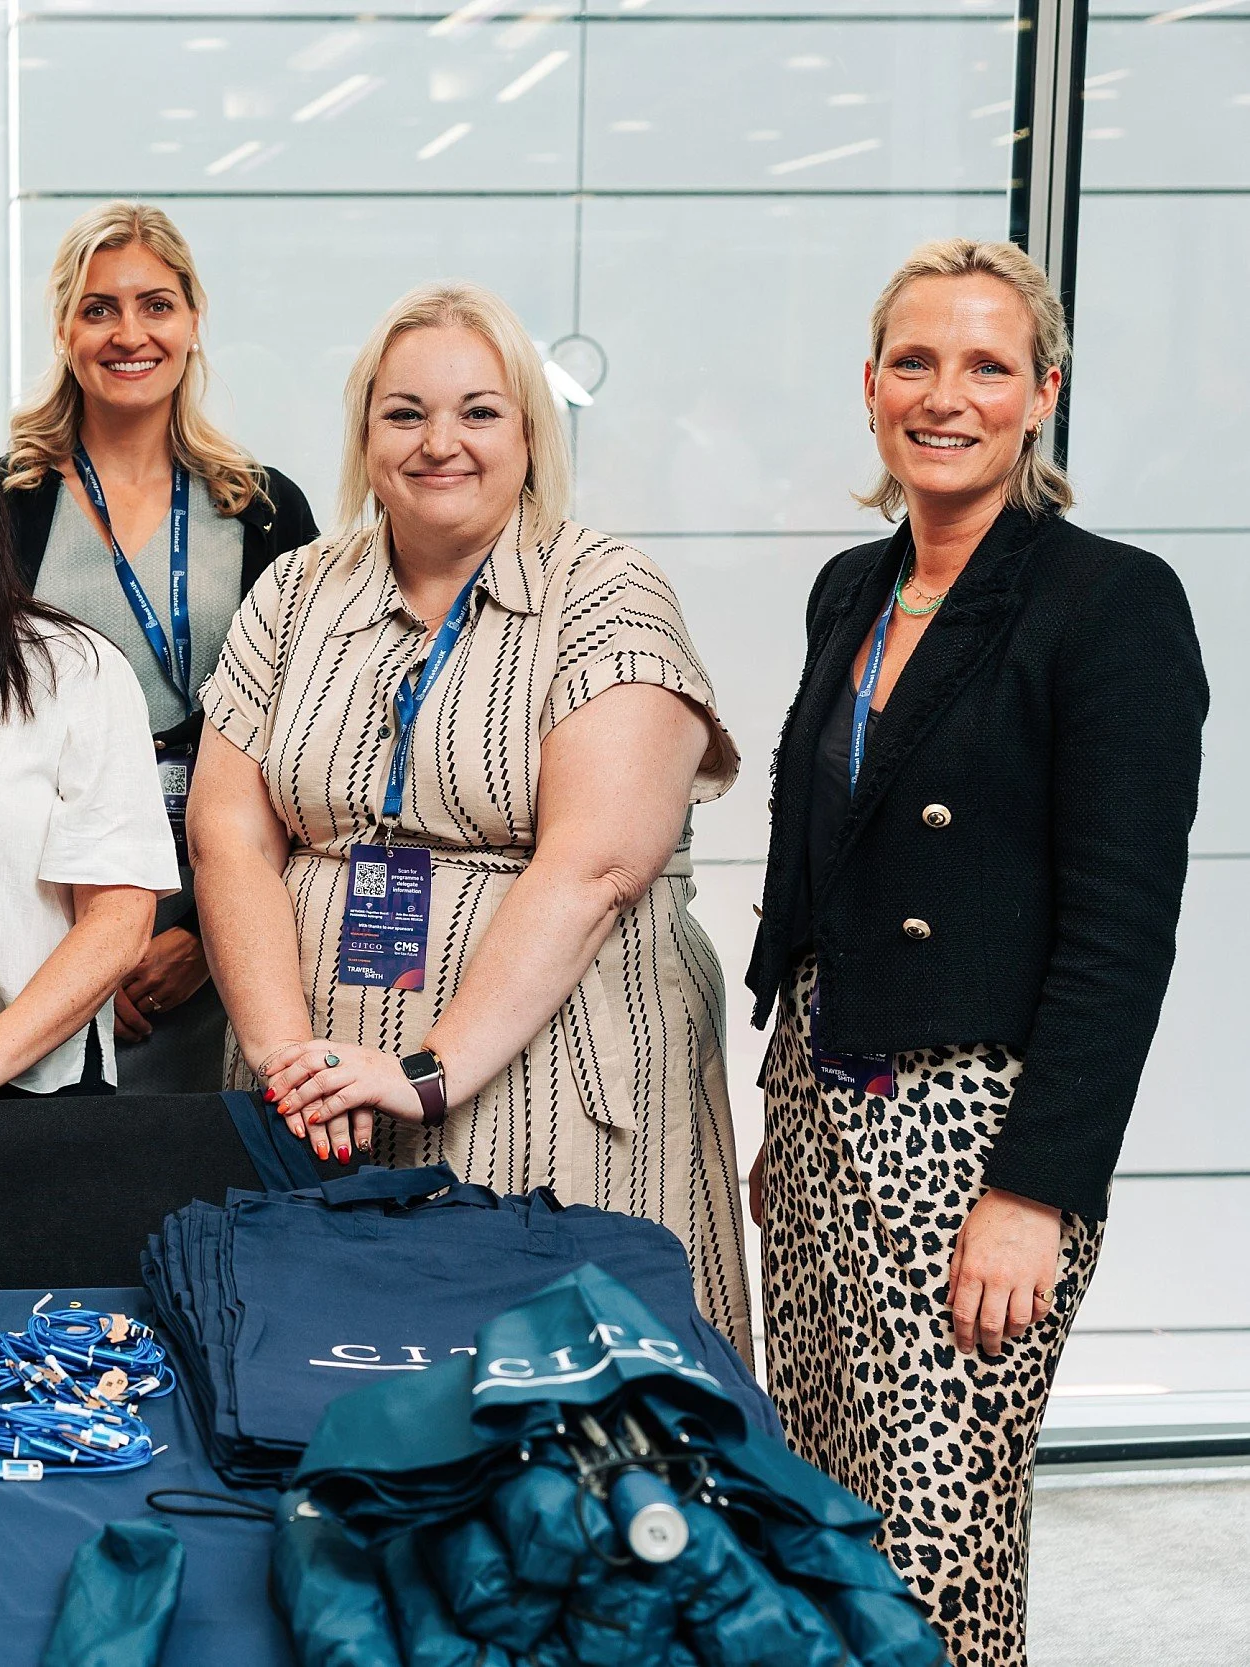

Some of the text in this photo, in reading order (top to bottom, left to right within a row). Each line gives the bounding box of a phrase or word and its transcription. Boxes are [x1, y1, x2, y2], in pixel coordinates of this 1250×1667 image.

[351, 941, 382, 950] CITCO
[394, 941, 419, 953] CMS
[488, 1323, 706, 1377] CITC
